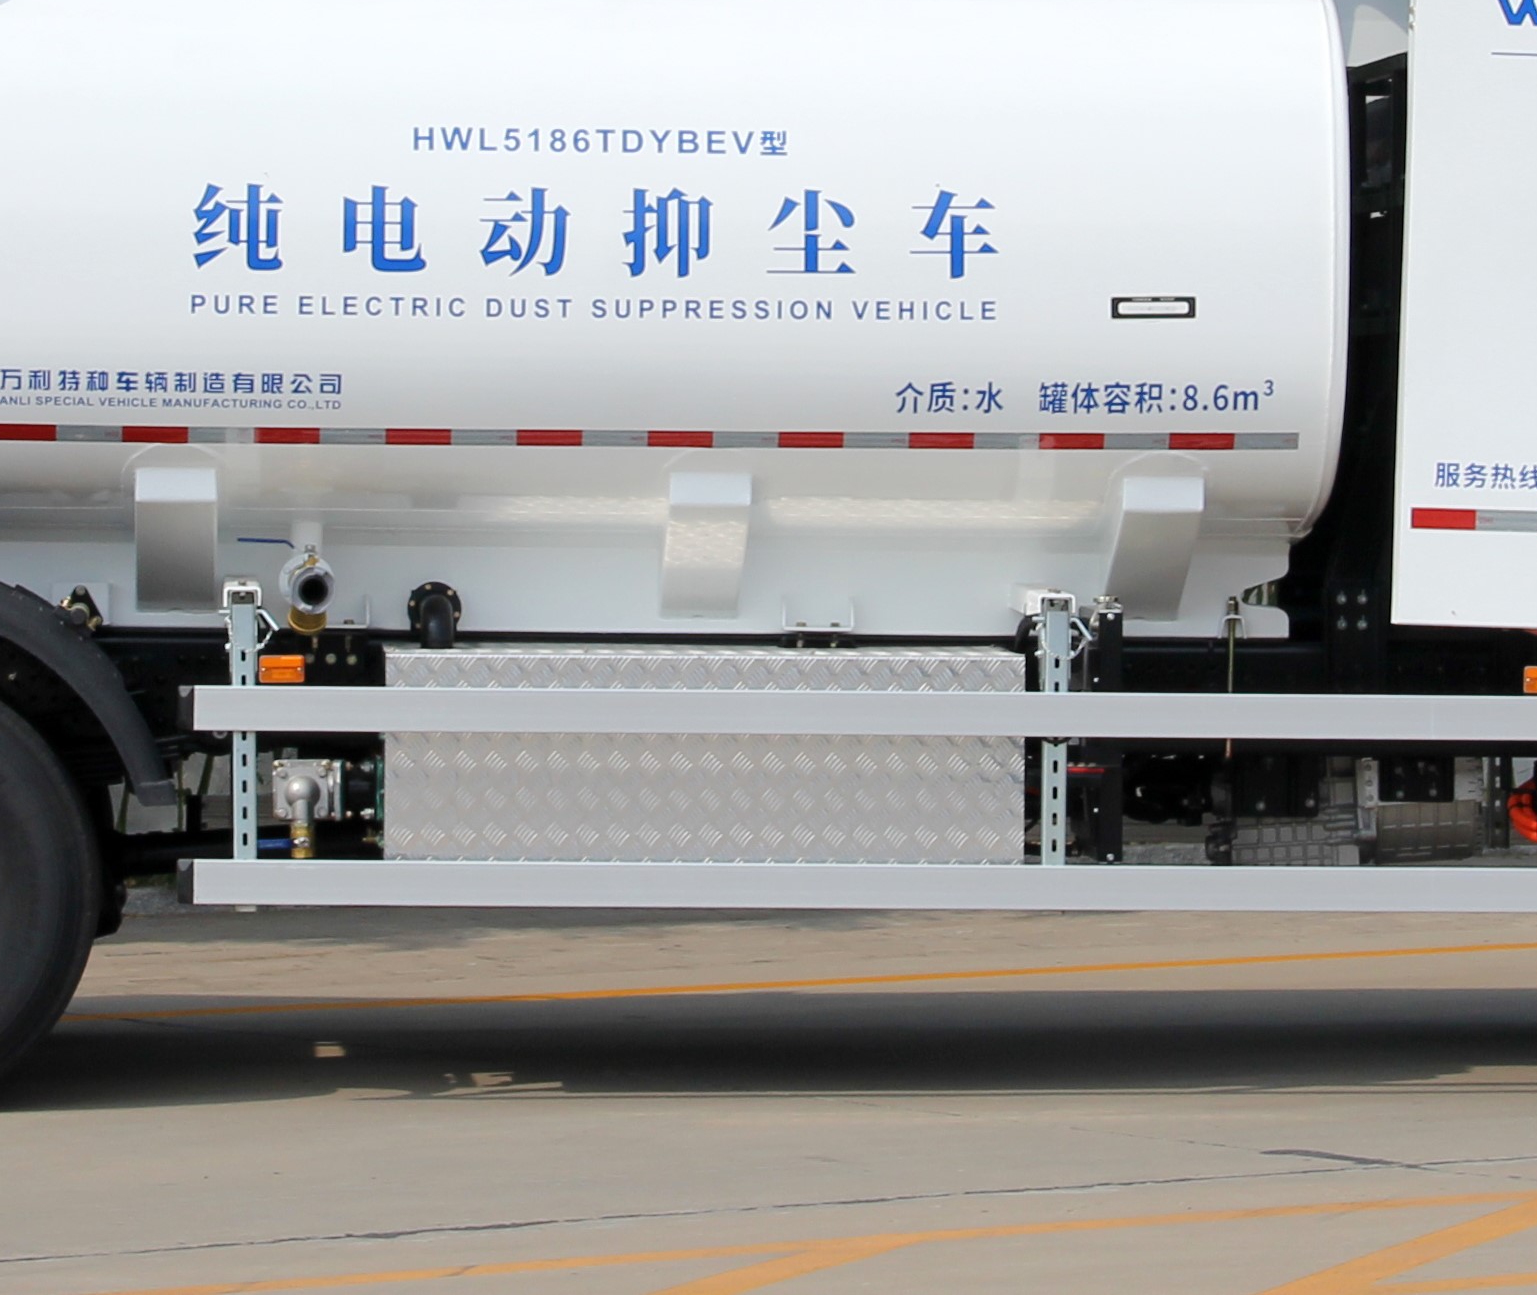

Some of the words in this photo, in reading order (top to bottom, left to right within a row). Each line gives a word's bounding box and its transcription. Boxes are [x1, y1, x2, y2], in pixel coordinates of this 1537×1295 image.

[412, 126, 788, 157] HWL5186TDYBEV型
[192, 182, 999, 280] 纯电动抑尘车
[190, 294, 278, 315] PURE
[298, 295, 465, 318] ELECTRIC
[485, 298, 572, 319] DUST
[591, 298, 832, 321] SUPPRESSION
[851, 300, 996, 321] VEHICLE
[35, 395, 94, 407] SPECIAL
[99, 396, 157, 408] VEHICLE
[162, 397, 283, 409] MANUFACTURING
[895, 381, 1004, 414] 介质:水
